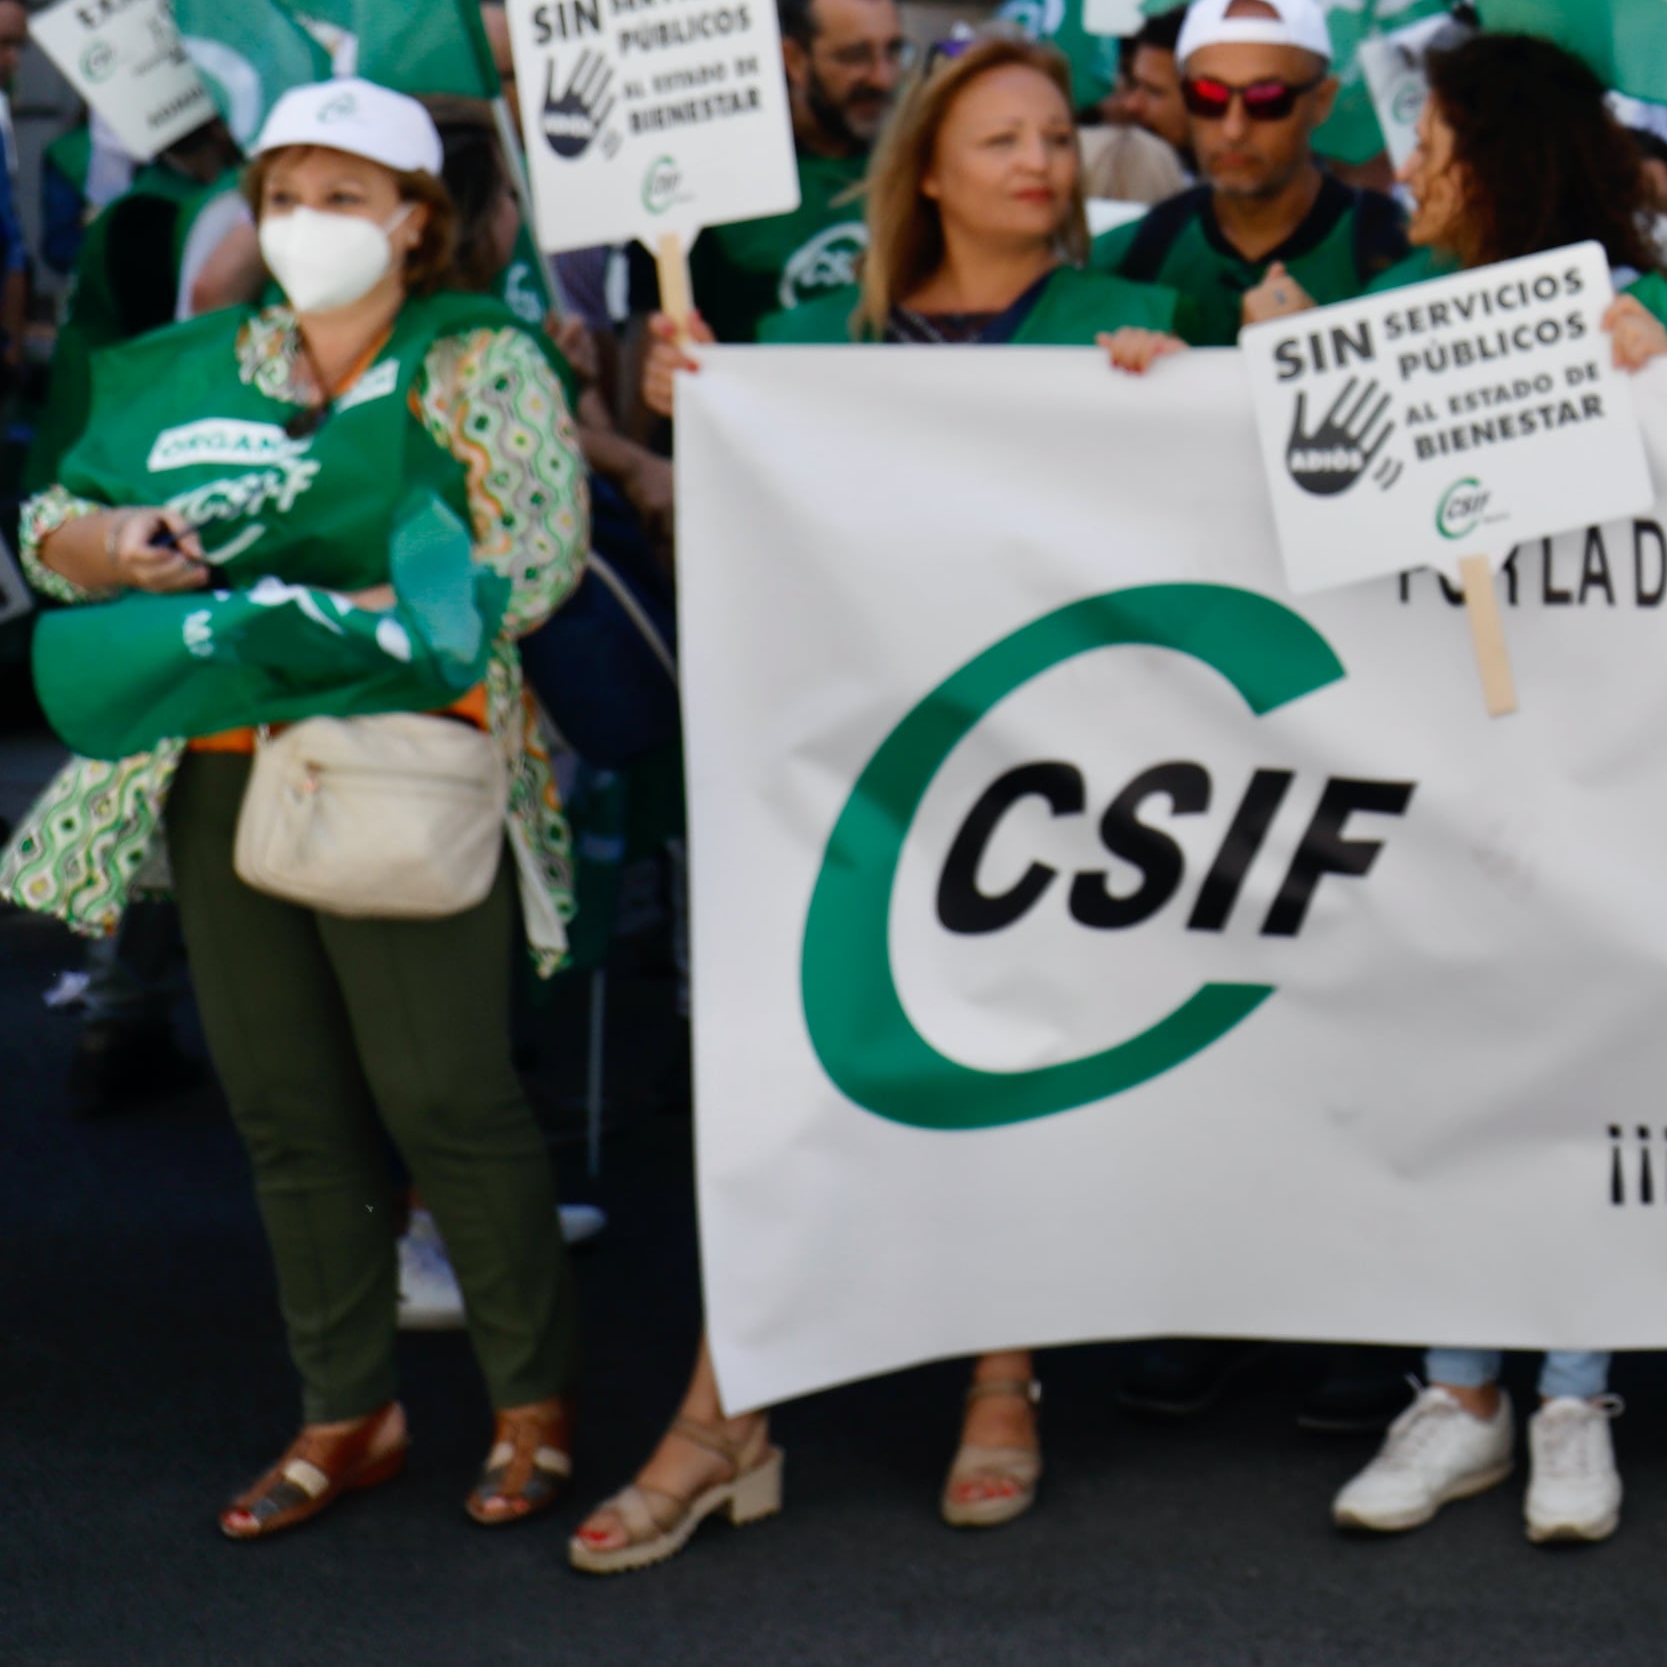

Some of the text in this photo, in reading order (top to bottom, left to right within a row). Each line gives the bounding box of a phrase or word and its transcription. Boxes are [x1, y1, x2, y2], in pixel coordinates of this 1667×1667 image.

[629, 85, 763, 134] BIENESTAR
[1274, 266, 1585, 384] SIN SERVICIOS
[1398, 310, 1588, 382] PÚBLICOS
[1405, 360, 1601, 428] AL ESTADO DE
[1413, 393, 1606, 463] BIENESTAR
[1537, 519, 1617, 609] LA
[935, 760, 1418, 937] CSIF
